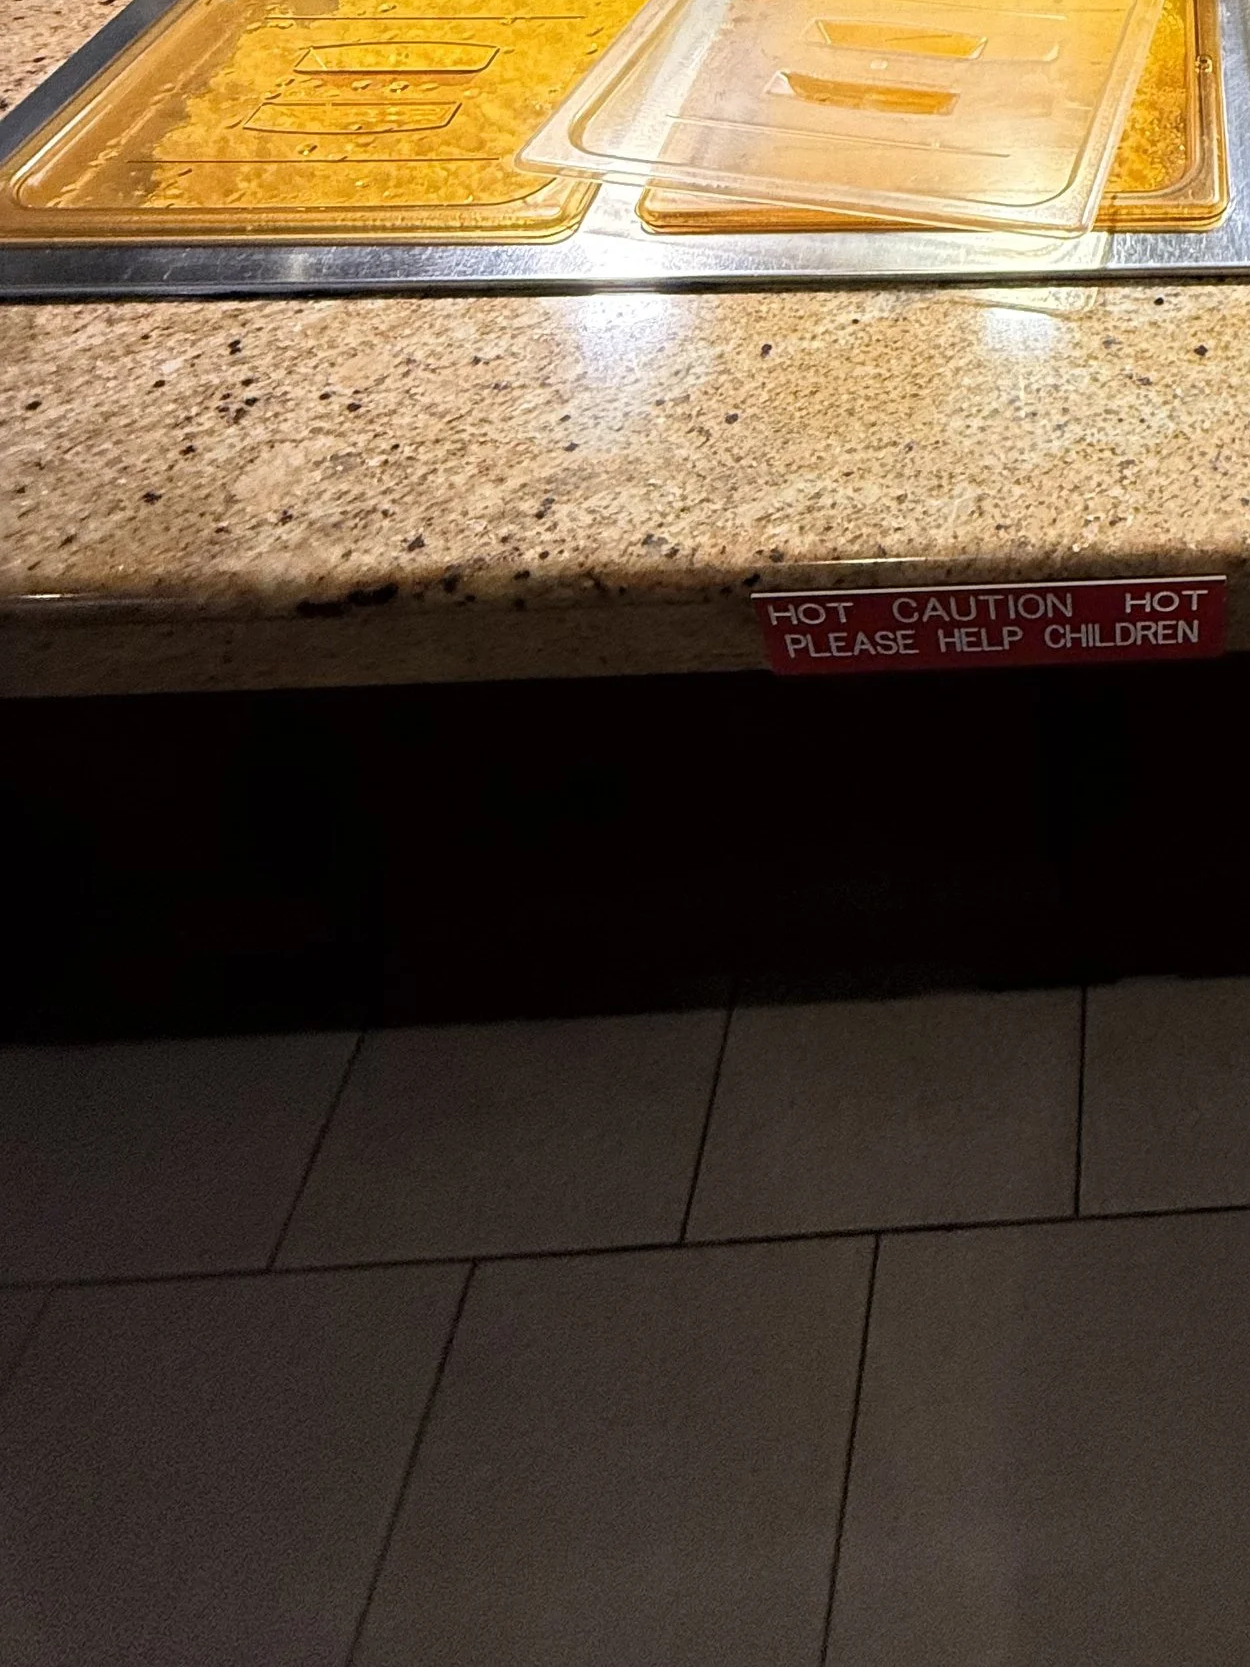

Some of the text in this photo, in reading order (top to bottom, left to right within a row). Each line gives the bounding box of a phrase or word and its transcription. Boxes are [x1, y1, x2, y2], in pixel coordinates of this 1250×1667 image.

[767, 589, 1209, 626] HOT CAUTION HOT
[784, 619, 1199, 659] PLEASE HELP CHILDREN
